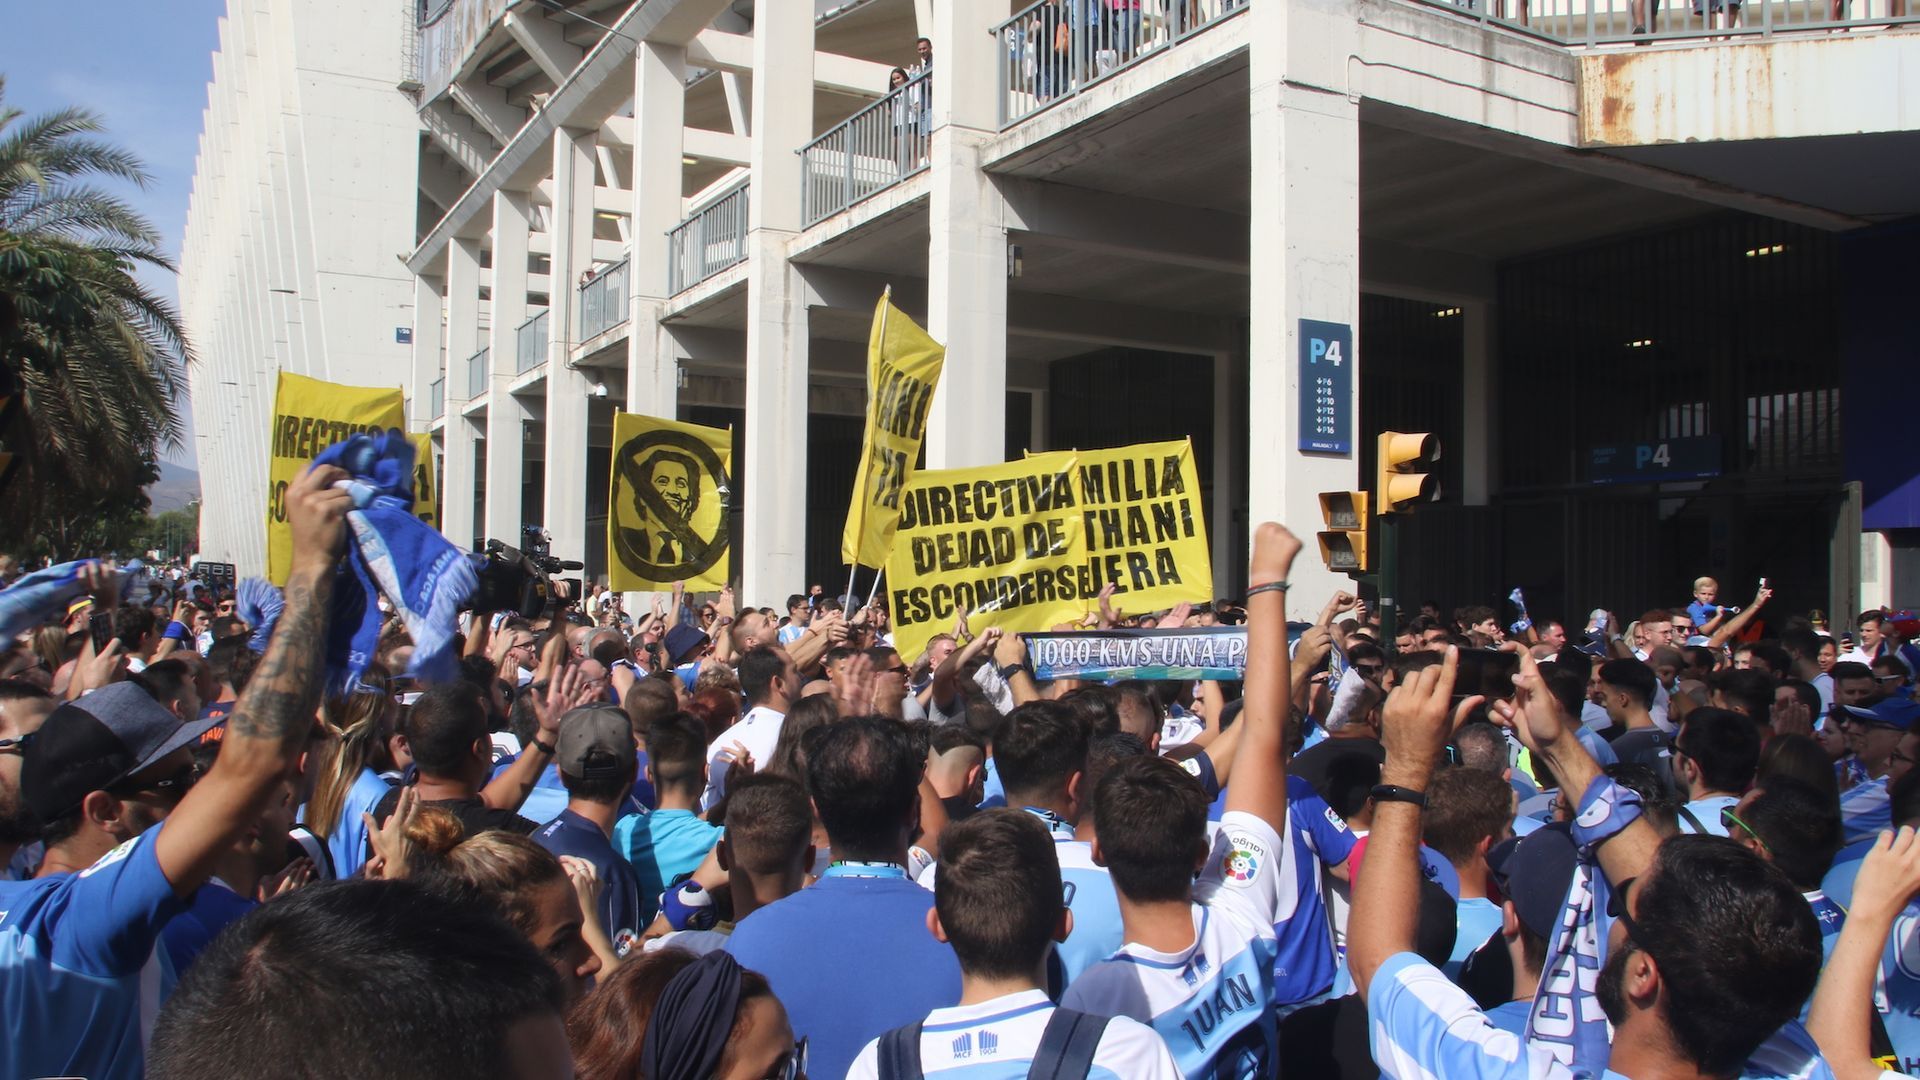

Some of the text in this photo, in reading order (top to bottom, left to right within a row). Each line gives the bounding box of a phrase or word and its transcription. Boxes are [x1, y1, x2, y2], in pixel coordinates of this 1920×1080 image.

[1310, 338, 1342, 366] P4
[1323, 407, 1334, 415] P12
[1635, 444, 1670, 469] P4
[912, 519, 1068, 576] DEJAD DE
[1036, 638, 1090, 666] 1000
[1099, 637, 1152, 666] KMS
[1161, 637, 1215, 667] UNA
[1181, 973, 1257, 1054] JUAN
